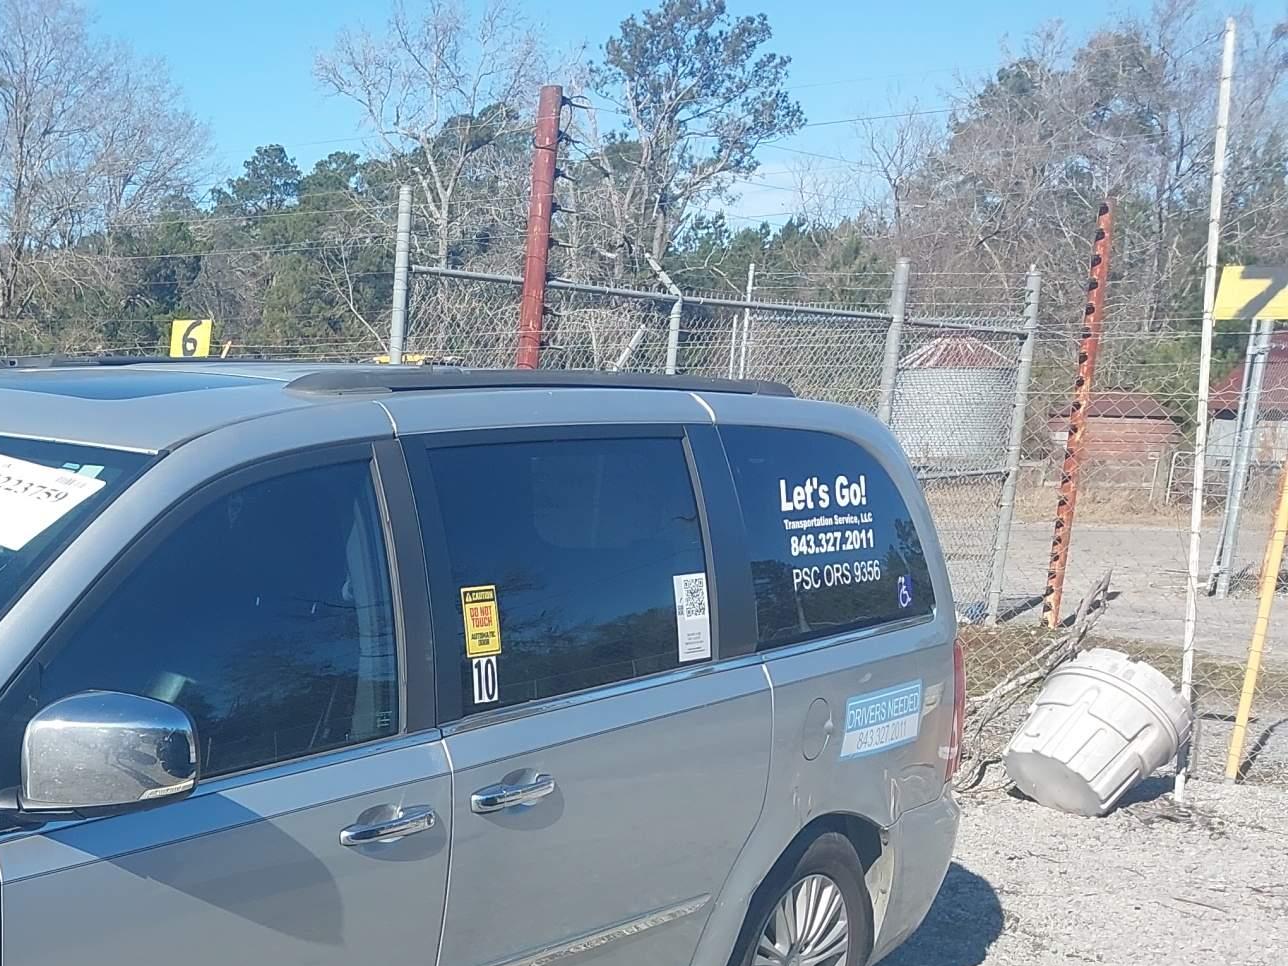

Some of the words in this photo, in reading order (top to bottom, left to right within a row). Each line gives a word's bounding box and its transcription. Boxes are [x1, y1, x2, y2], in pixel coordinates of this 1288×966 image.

[1232, 264, 1288, 319] 7
[182, 320, 202, 356] 6
[779, 477, 830, 512] Let's
[835, 475, 867, 507] Go!
[783, 515, 833, 531] Transportation
[834, 513, 860, 526] Service,
[861, 512, 873, 523] LLC
[790, 529, 874, 556] 843.327.2011
[792, 567, 821, 591] PSC
[824, 563, 852, 587] ORS
[854, 560, 881, 582] 9356
[470, 607, 479, 617] DO
[480, 606, 492, 616] NOT
[472, 617, 493, 628] TOUCH
[474, 658, 496, 701] 10
[848, 704, 886, 729] DRIVERS
[888, 693, 919, 716] NEEDED
[856, 720, 907, 749] 843.327.2011
